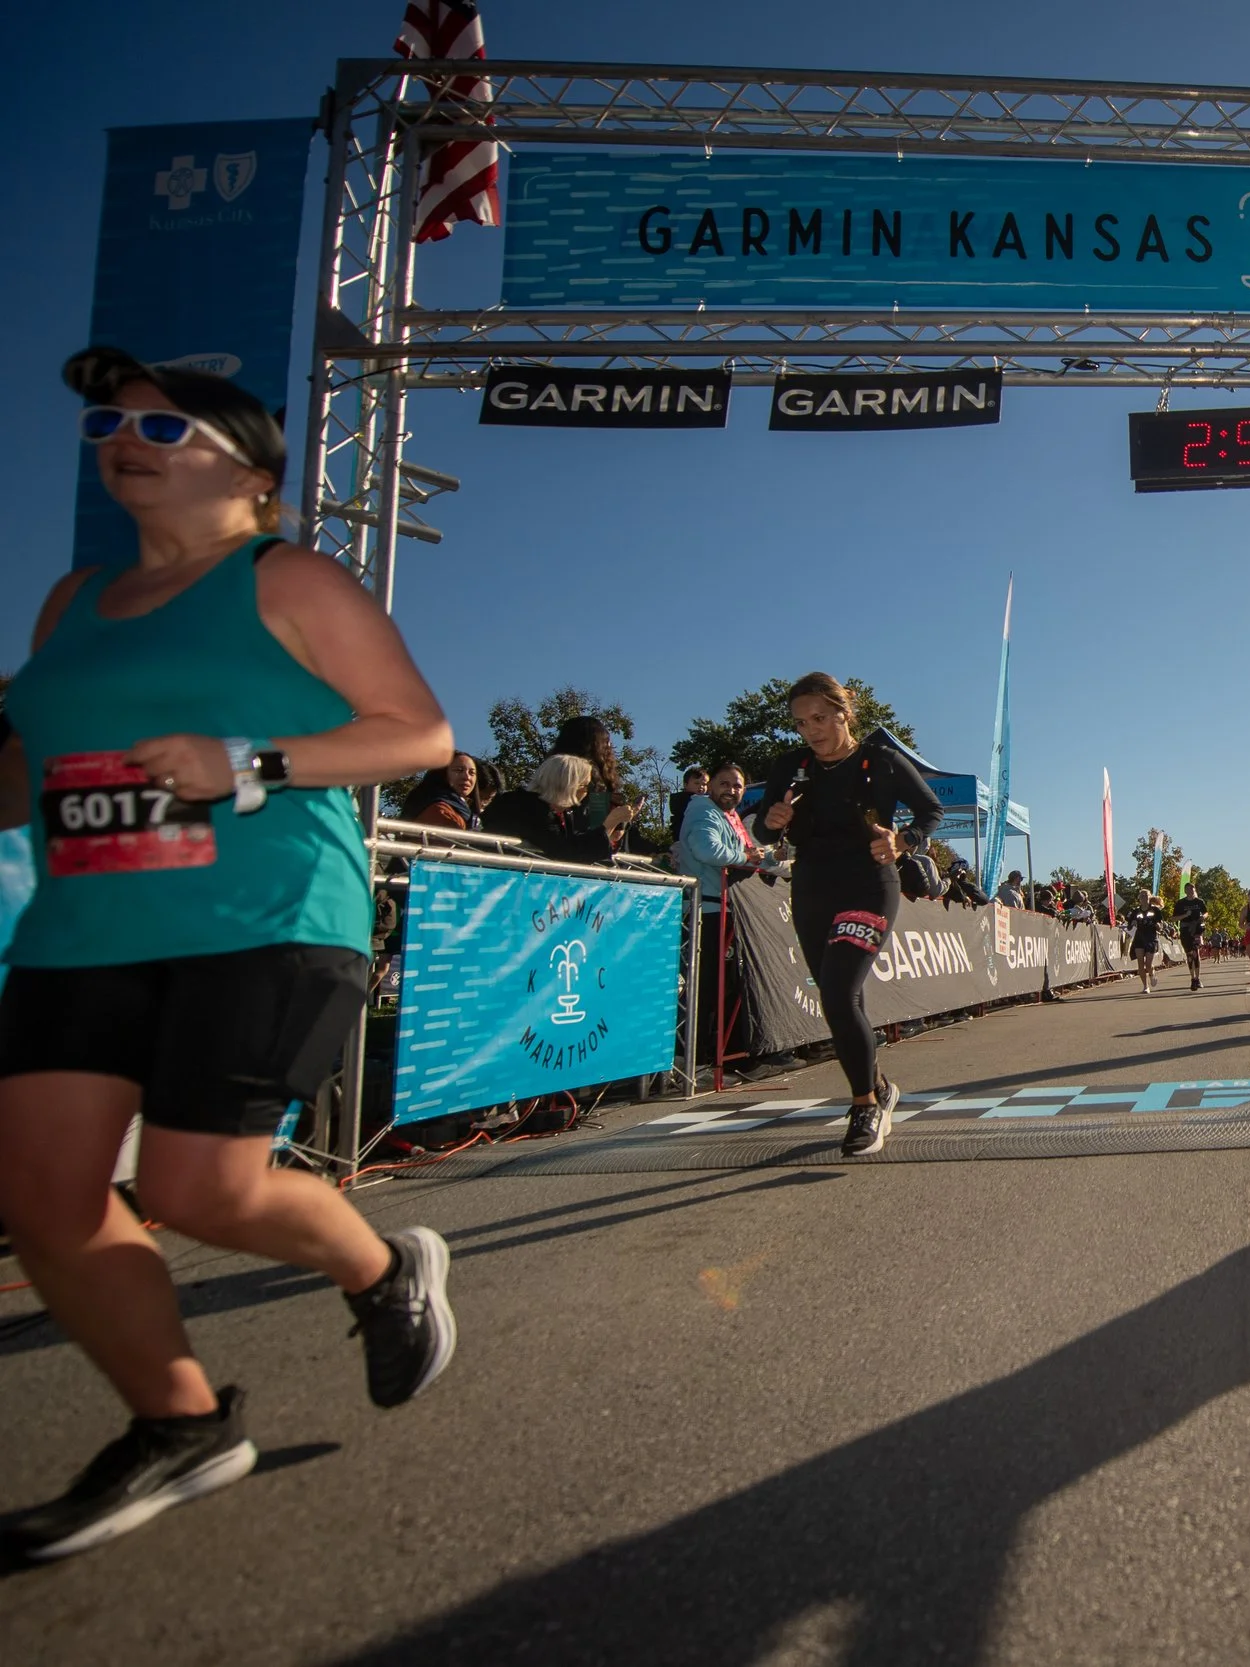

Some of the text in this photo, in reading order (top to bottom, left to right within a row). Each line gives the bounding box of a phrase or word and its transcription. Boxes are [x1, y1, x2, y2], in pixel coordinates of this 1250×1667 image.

[638, 204, 902, 257] GARMIN
[949, 210, 1213, 263] KANSAS
[489, 381, 716, 414] GARMIN
[776, 381, 988, 417] GARMIN
[59, 789, 174, 830] 6017
[532, 896, 605, 933] GARMIN
[837, 922, 875, 941] 5052
[871, 930, 972, 983] GARMIN
[1006, 934, 1049, 969] GARMIN
[527, 967, 606, 993] K C
[795, 985, 823, 1018] MARA
[519, 1017, 609, 1070] MARATHON
